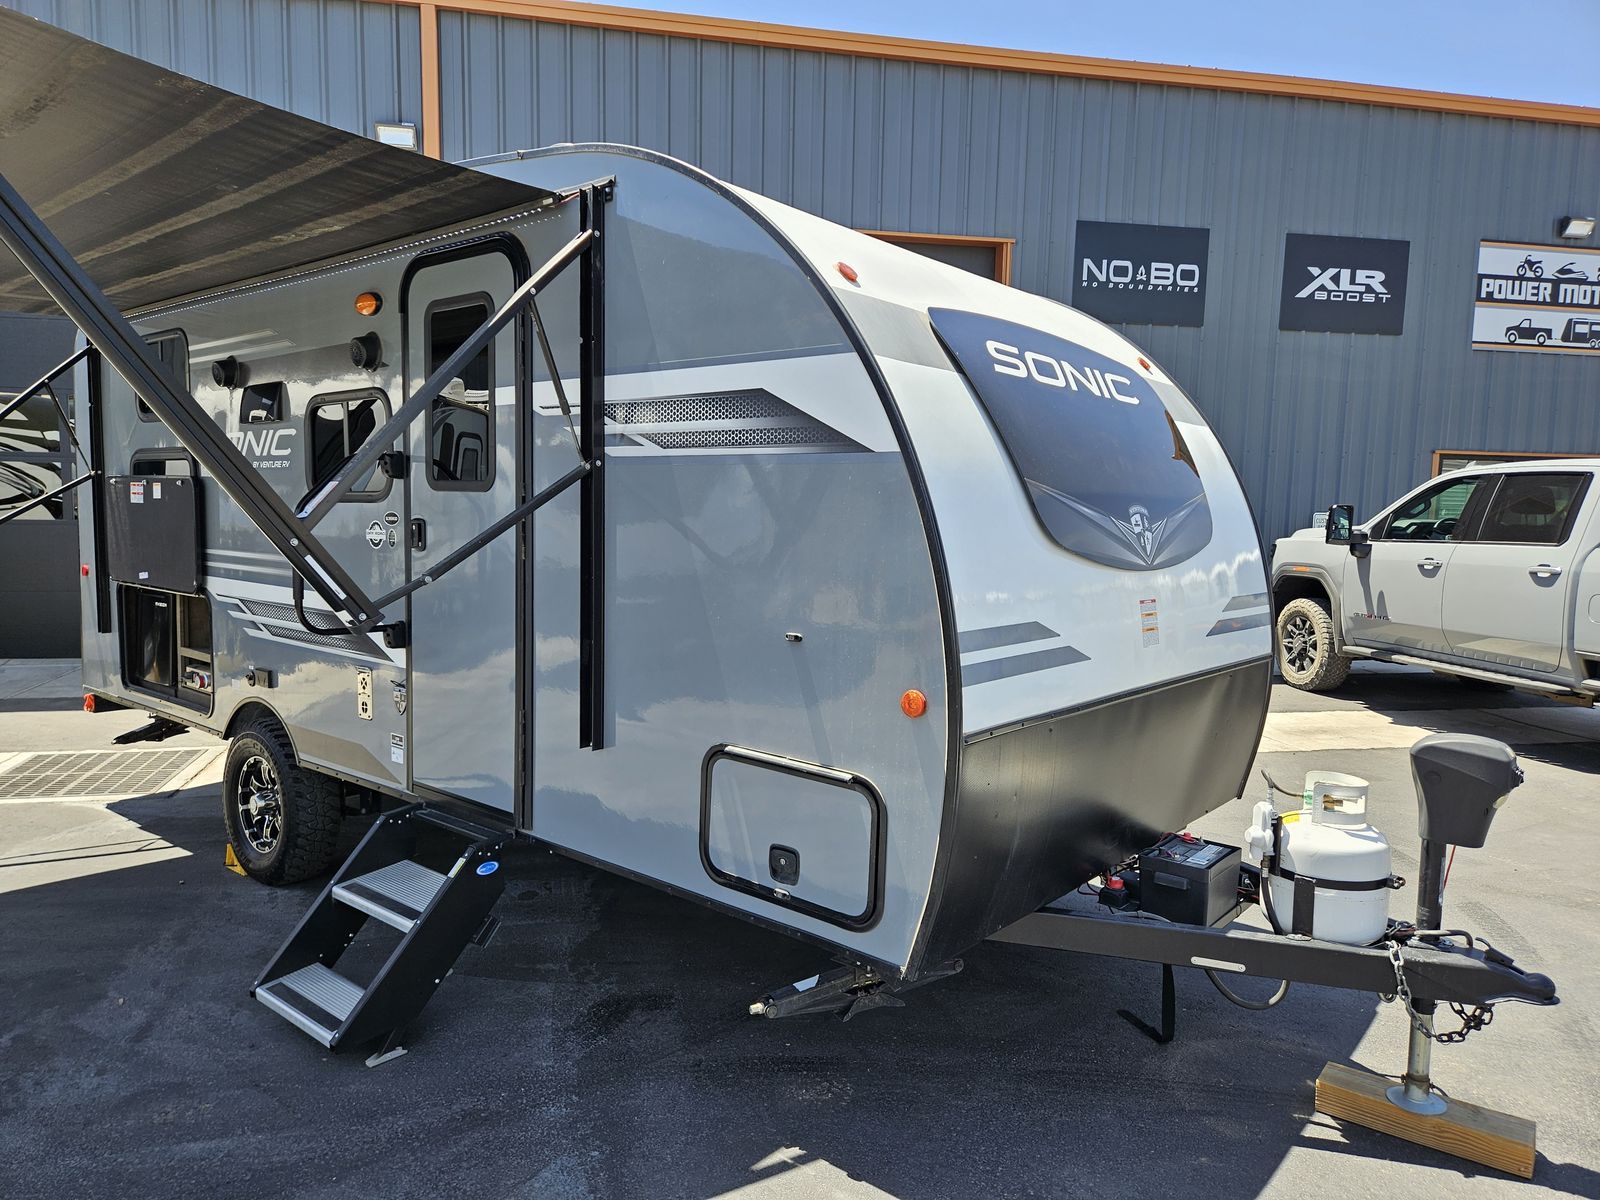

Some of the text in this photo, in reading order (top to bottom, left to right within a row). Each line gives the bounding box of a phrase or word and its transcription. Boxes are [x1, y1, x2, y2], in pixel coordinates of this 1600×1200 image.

[1109, 282, 1198, 292] BOUNDARIES
[1295, 266, 1388, 298] XLR
[1481, 279, 1600, 305] POWER MOT
[1314, 291, 1391, 303] BOOST
[986, 340, 1140, 405] SONIC
[226, 428, 297, 456] ONIC
[260, 460, 282, 468] VENTURE
[282, 460, 291, 468] RV
